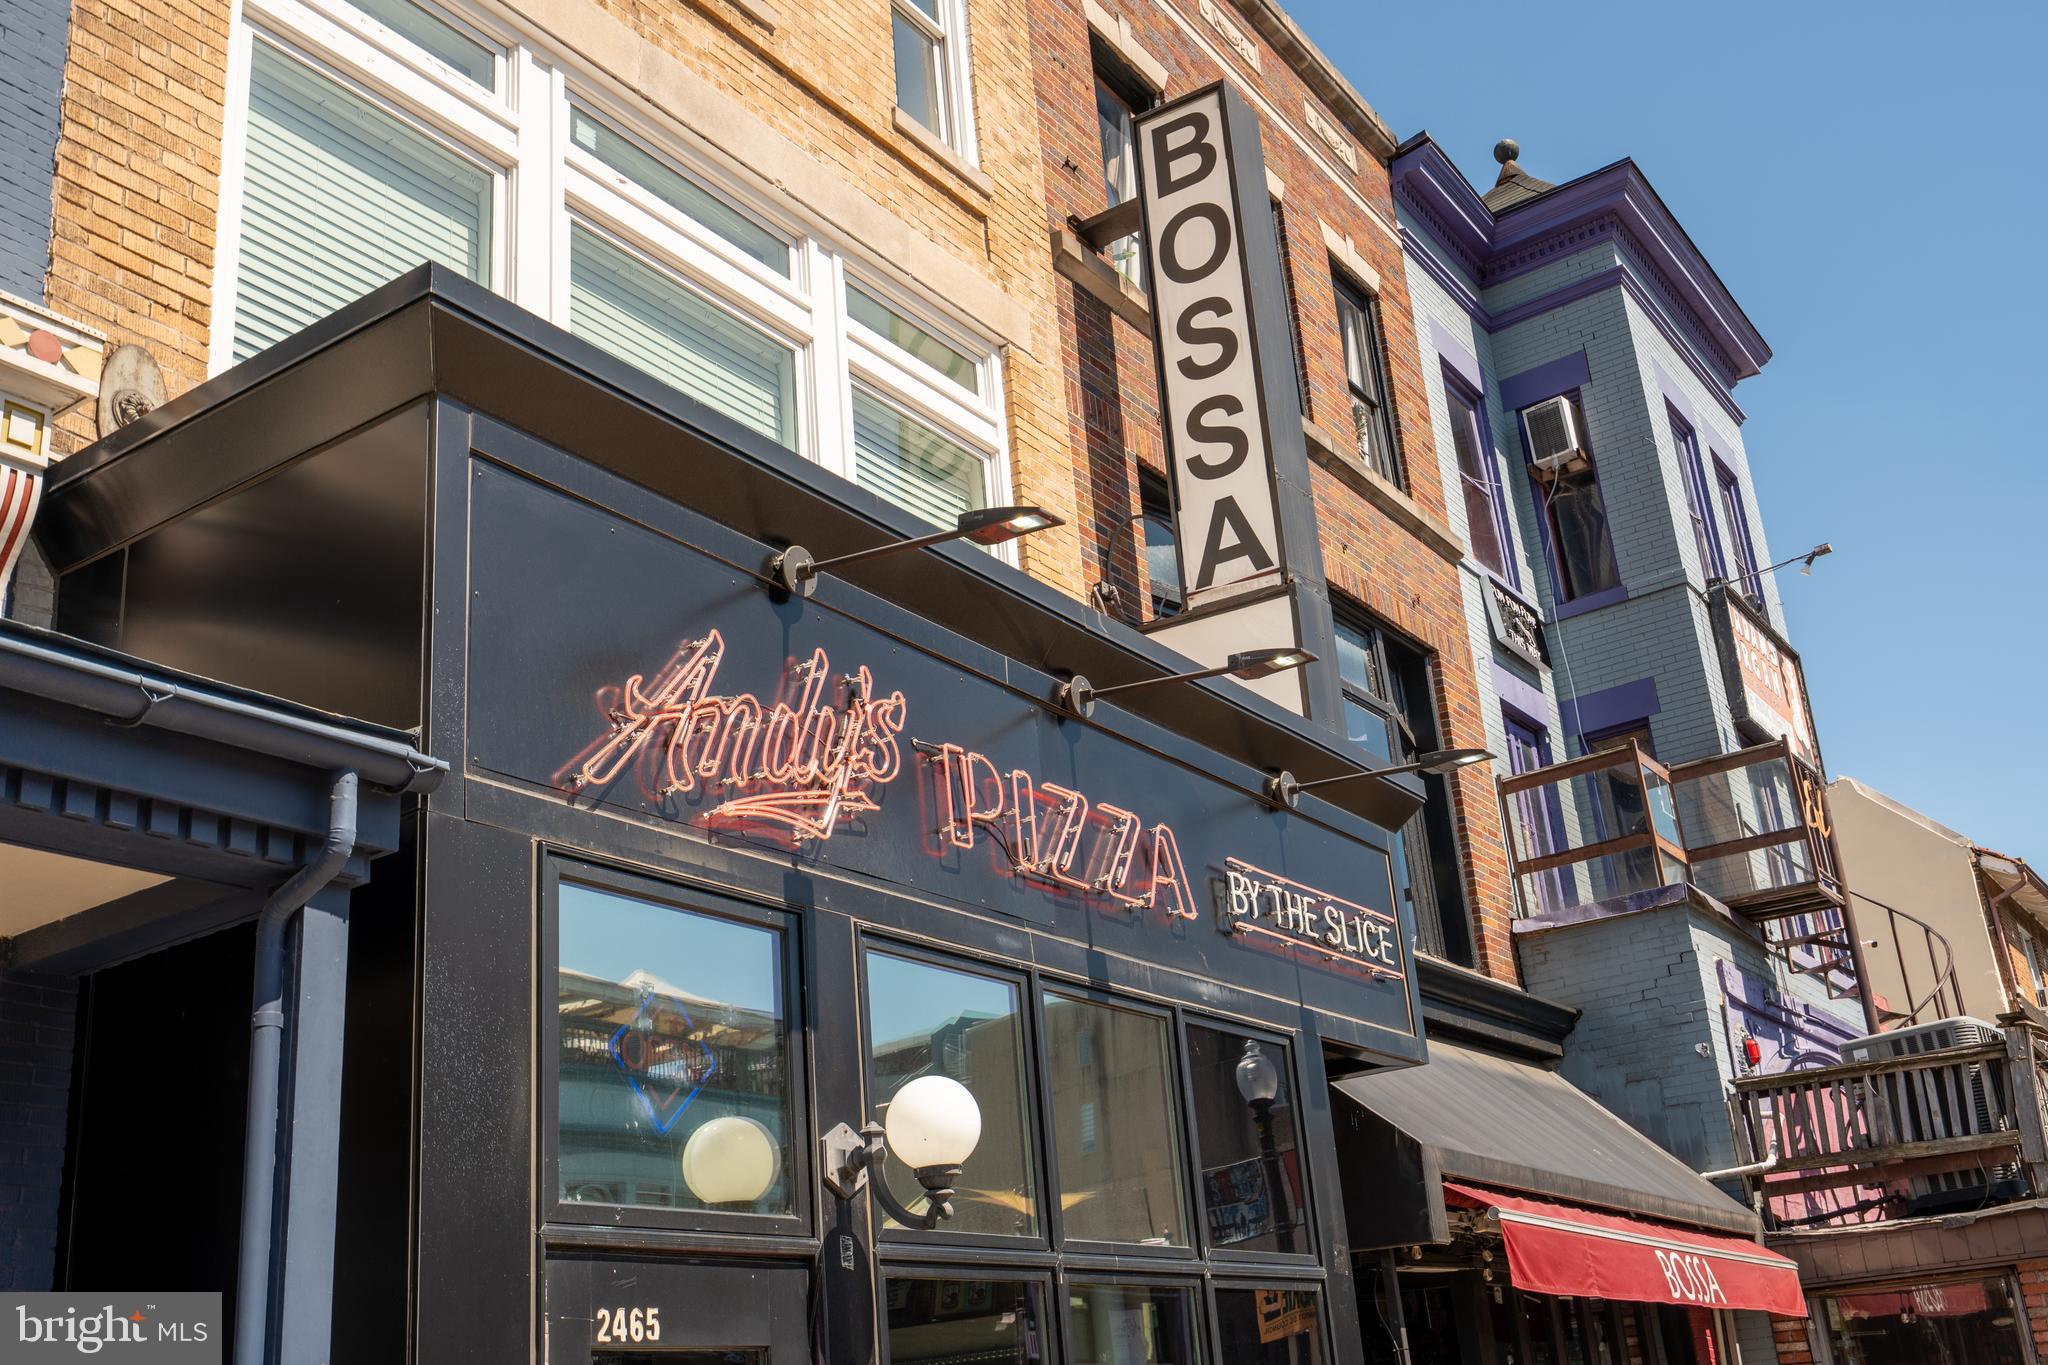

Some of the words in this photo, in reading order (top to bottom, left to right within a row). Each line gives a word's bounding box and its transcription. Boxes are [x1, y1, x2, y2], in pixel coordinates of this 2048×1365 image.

[1151, 111, 1275, 591] BOSSA
[583, 628, 906, 839] Andy's
[943, 742, 1199, 920] PIZZA
[1227, 871, 1260, 920] BY
[1266, 884, 1320, 939] THE
[1324, 905, 1396, 966] SLICE
[597, 1307, 661, 1342] 2465
[1654, 1249, 1728, 1305] BOSSA
